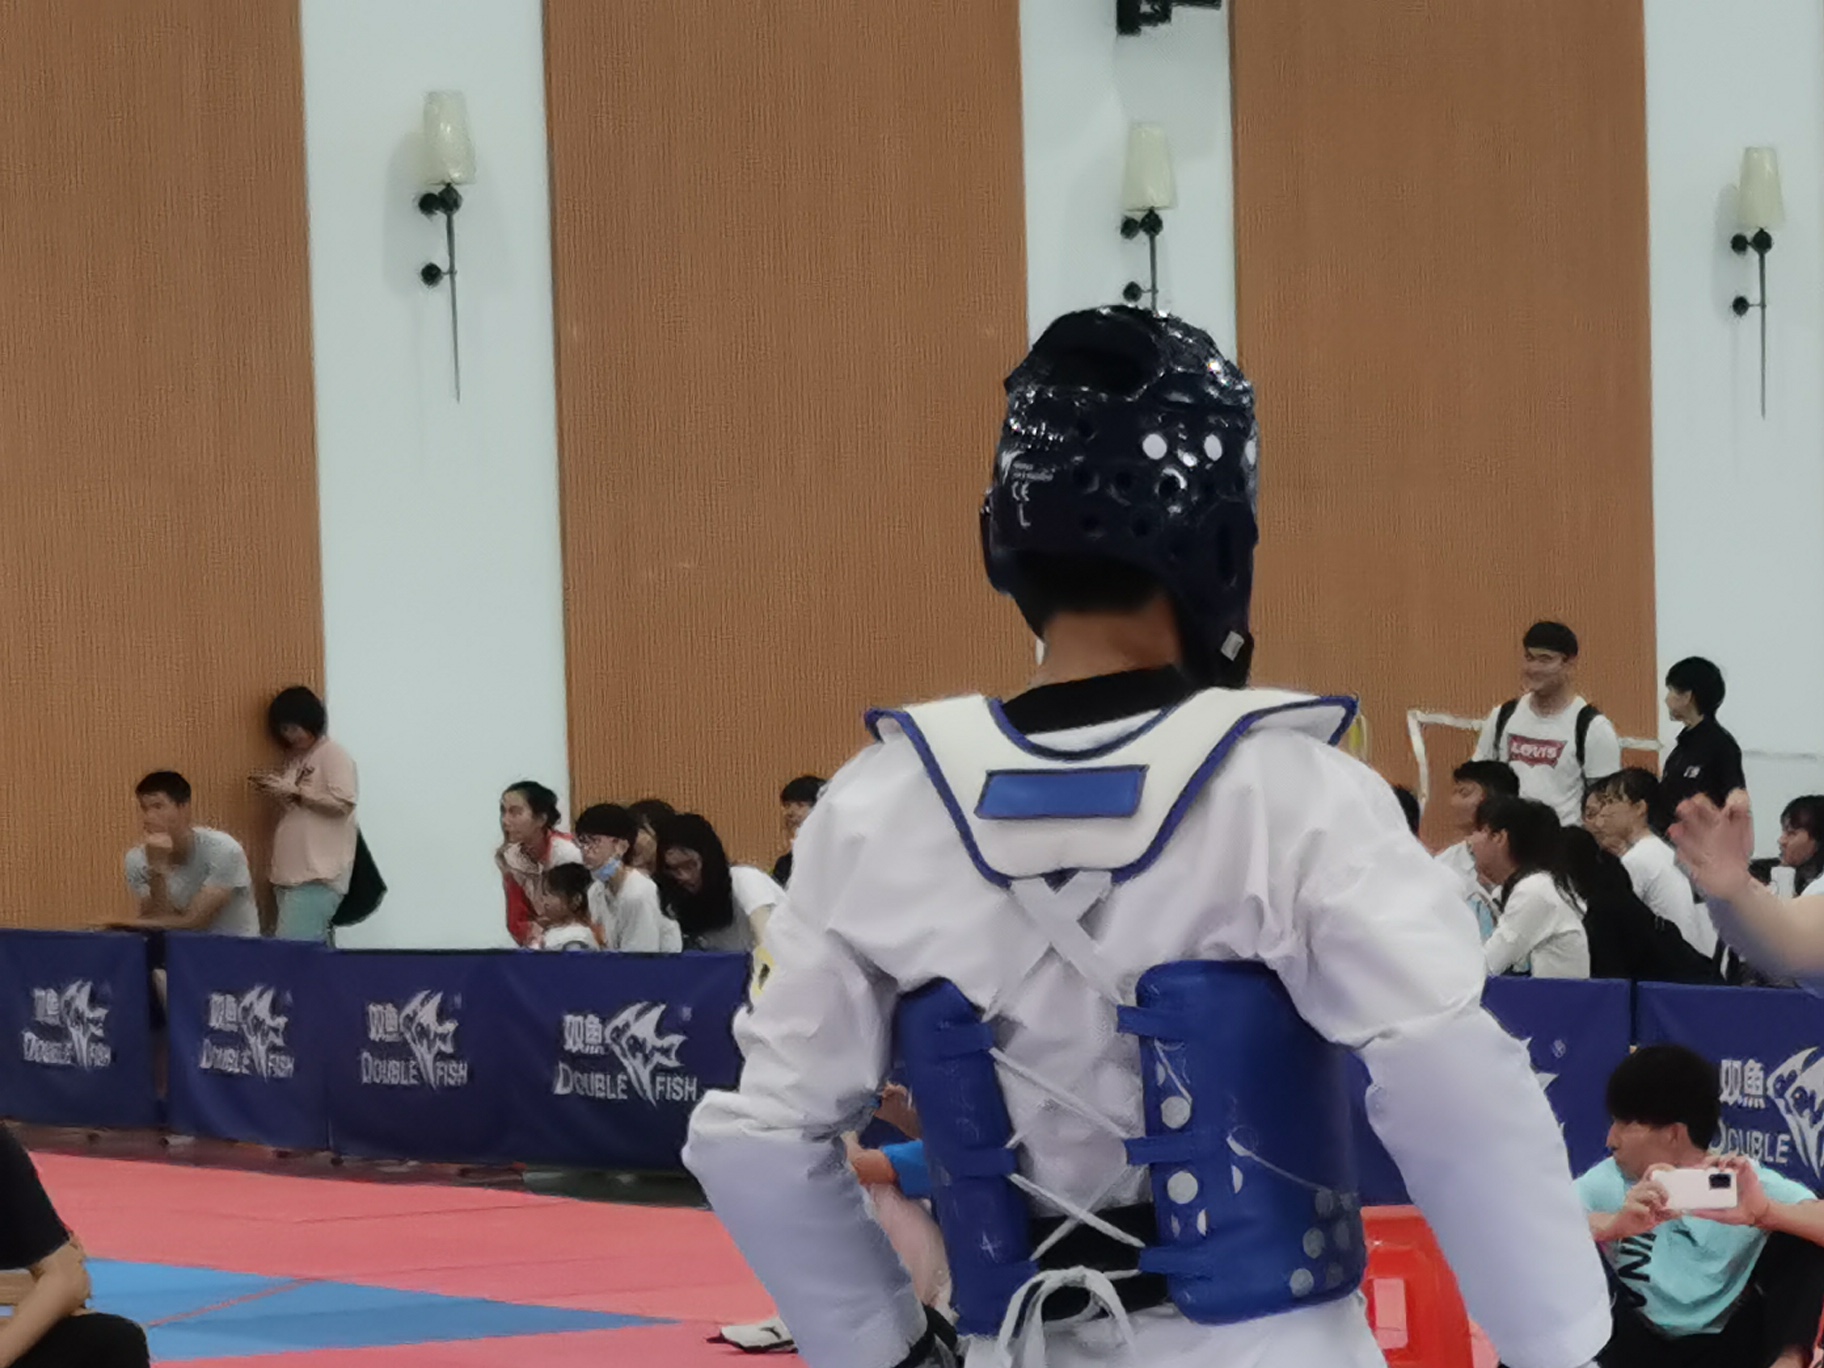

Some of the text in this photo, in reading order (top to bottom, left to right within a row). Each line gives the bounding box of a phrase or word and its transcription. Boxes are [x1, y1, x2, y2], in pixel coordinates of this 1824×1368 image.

[361, 1051, 468, 1087] DOUBLE FISH
[554, 1063, 697, 1101] DOUBLE FISH
